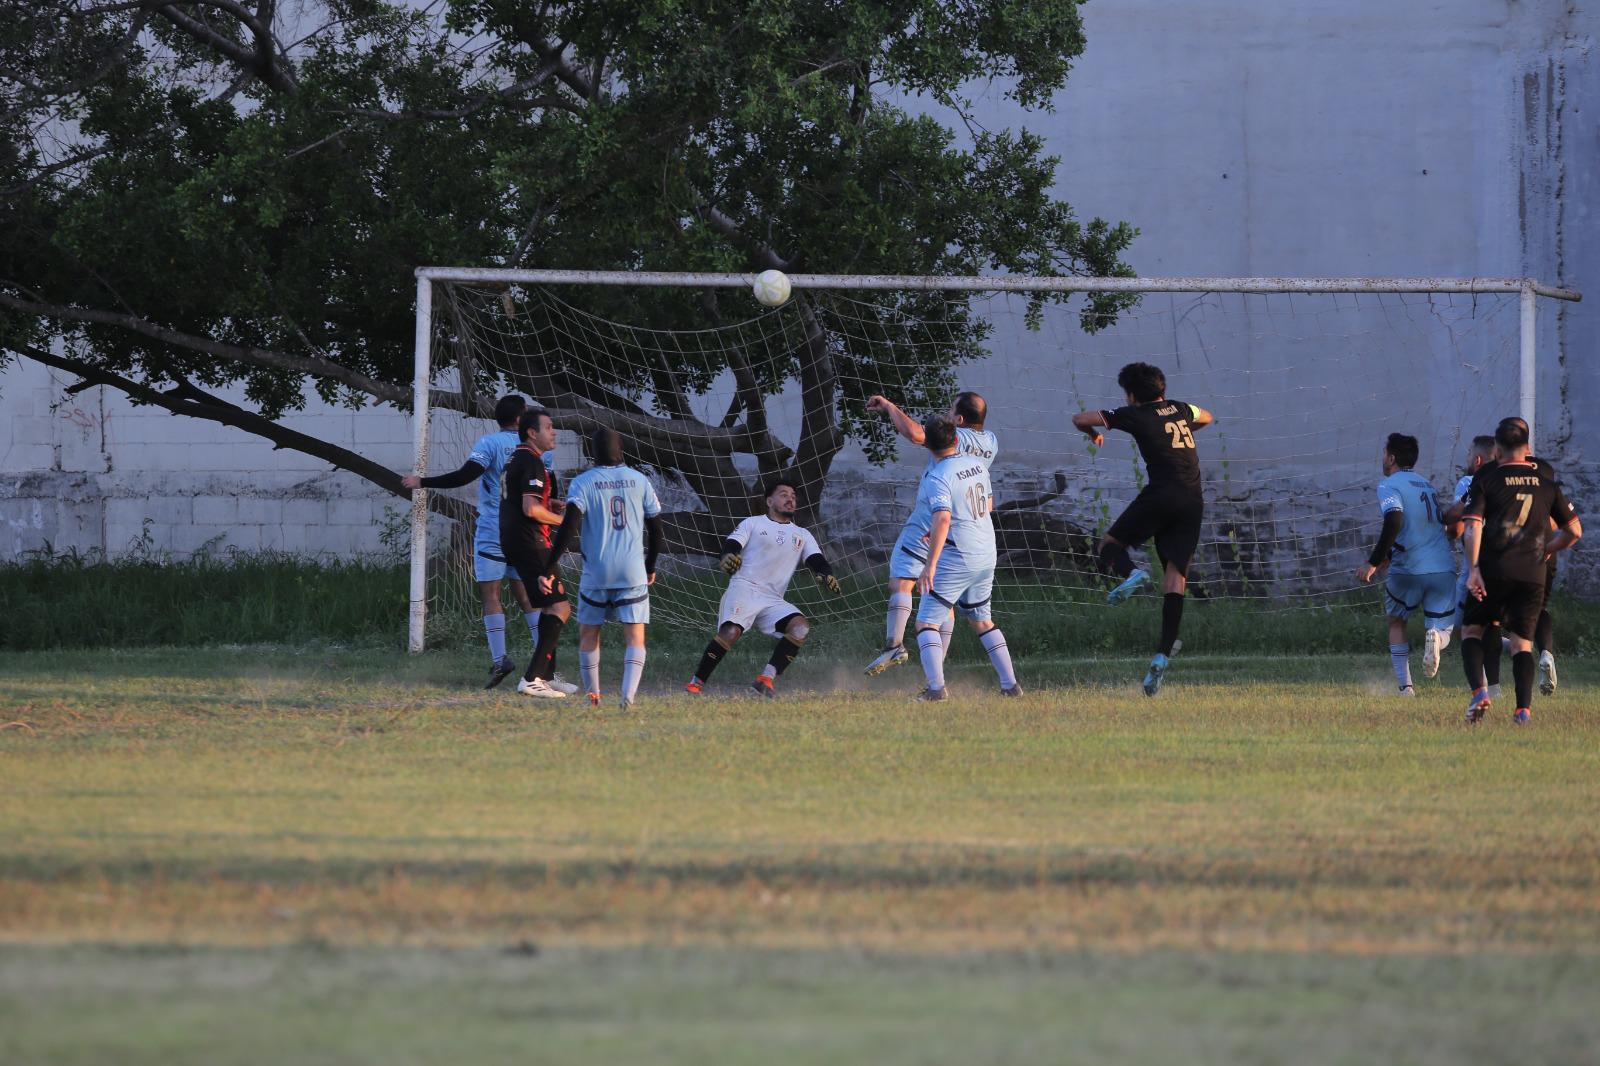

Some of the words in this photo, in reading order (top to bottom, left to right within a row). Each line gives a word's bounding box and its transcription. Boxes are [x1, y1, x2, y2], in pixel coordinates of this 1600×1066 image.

[1164, 419, 1196, 449] 25
[594, 479, 636, 490] MARCELO
[955, 465, 983, 481] ISAAC
[1504, 476, 1540, 487] MMTR
[610, 495, 627, 531] 9
[965, 482, 987, 521] 16
[1515, 493, 1533, 527] 7
